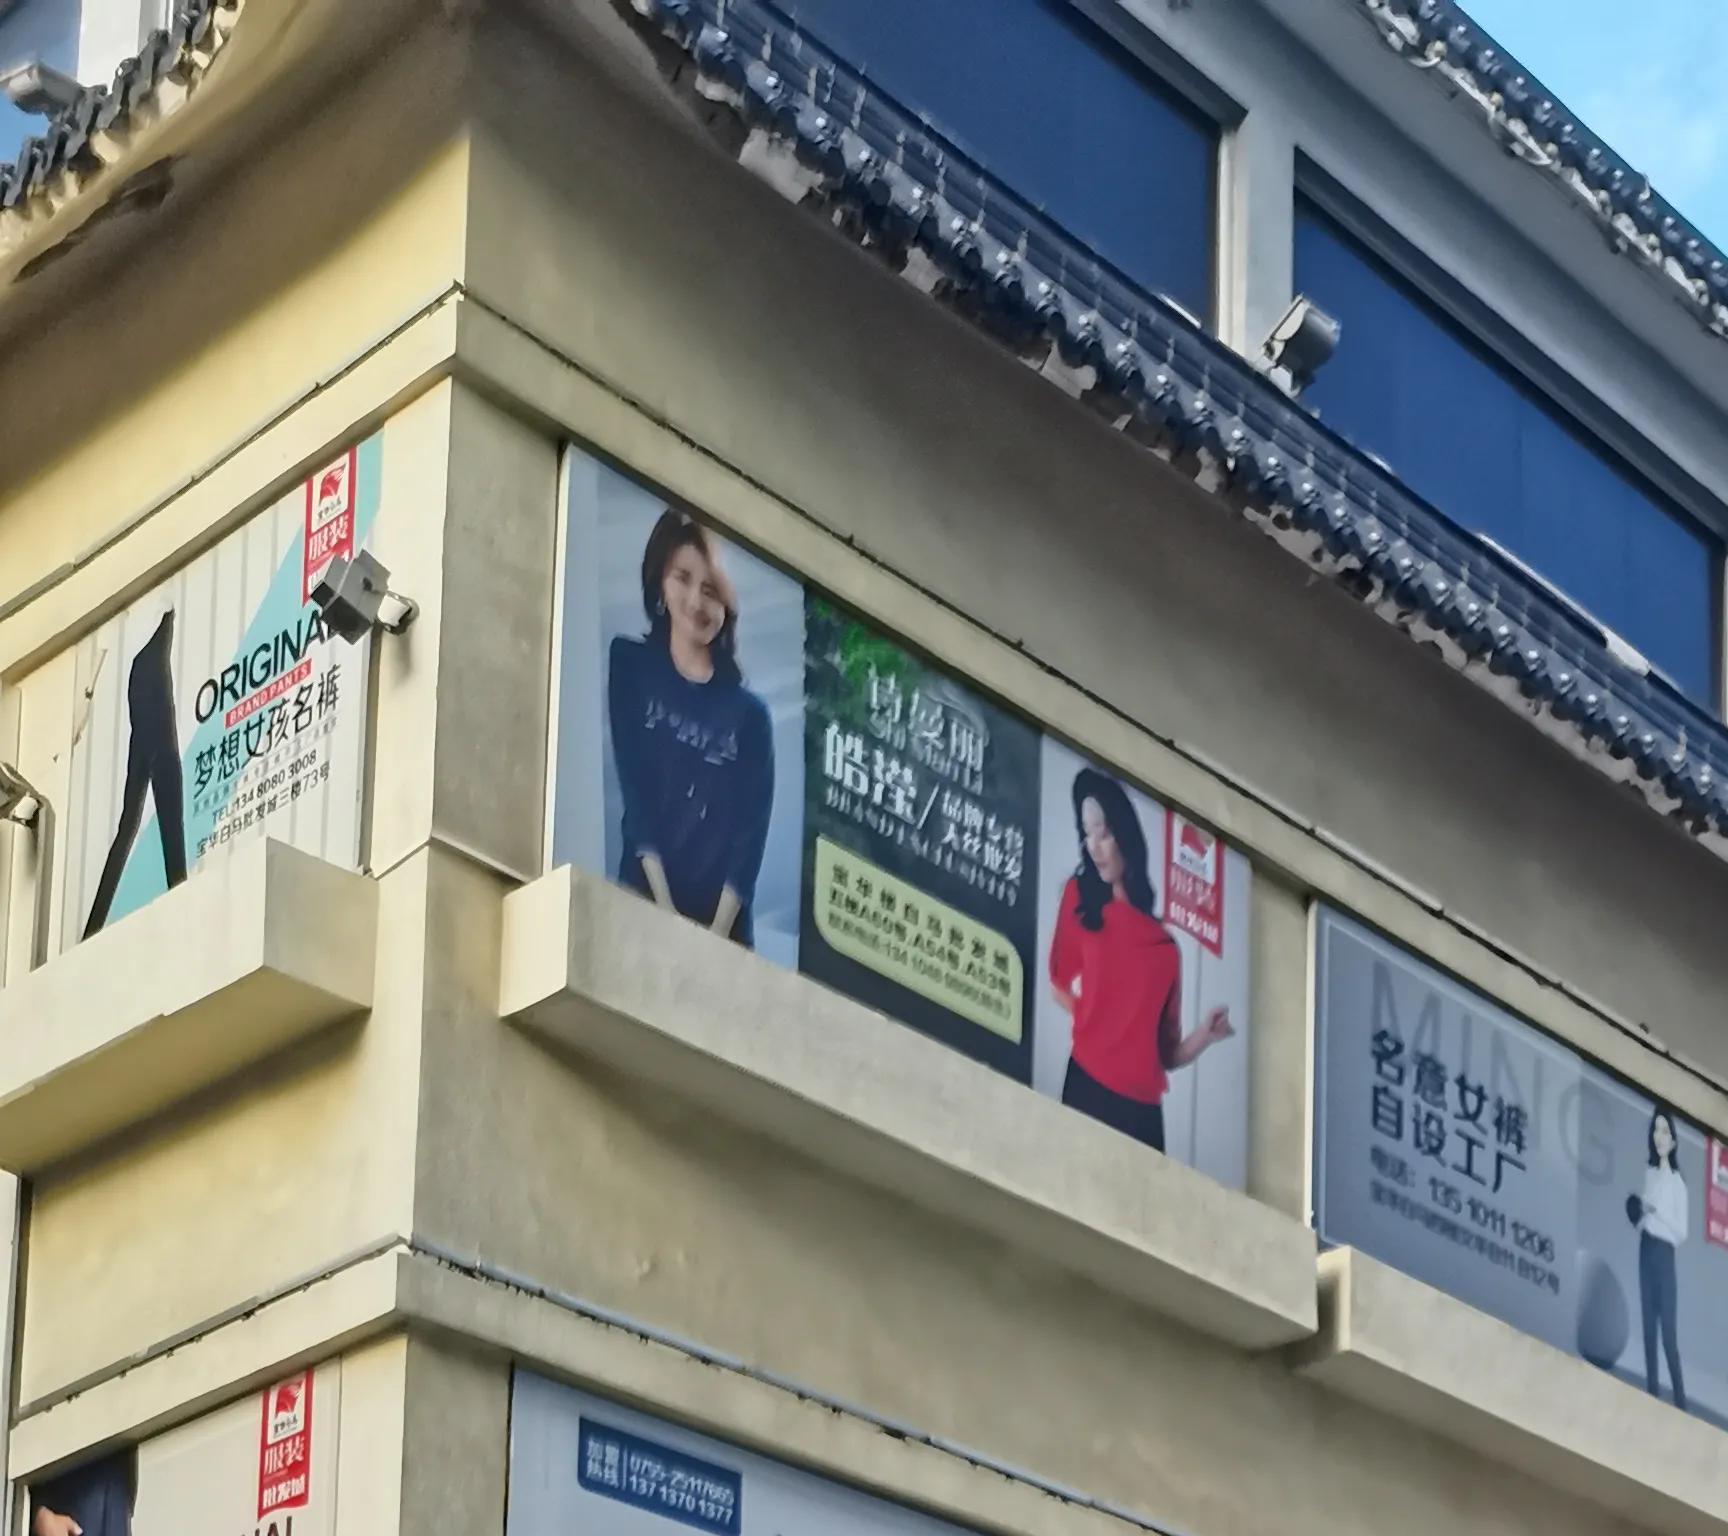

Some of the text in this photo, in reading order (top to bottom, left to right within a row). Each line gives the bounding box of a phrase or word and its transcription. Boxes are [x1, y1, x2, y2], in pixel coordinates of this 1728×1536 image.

[195, 608, 330, 723] ORIGINA
[229, 663, 310, 726] BRAND PANTS
[193, 664, 341, 798] 梦想女孩名裤
[1371, 1084, 1528, 1193] 自设工厂
[264, 1436, 305, 1476] 服装
